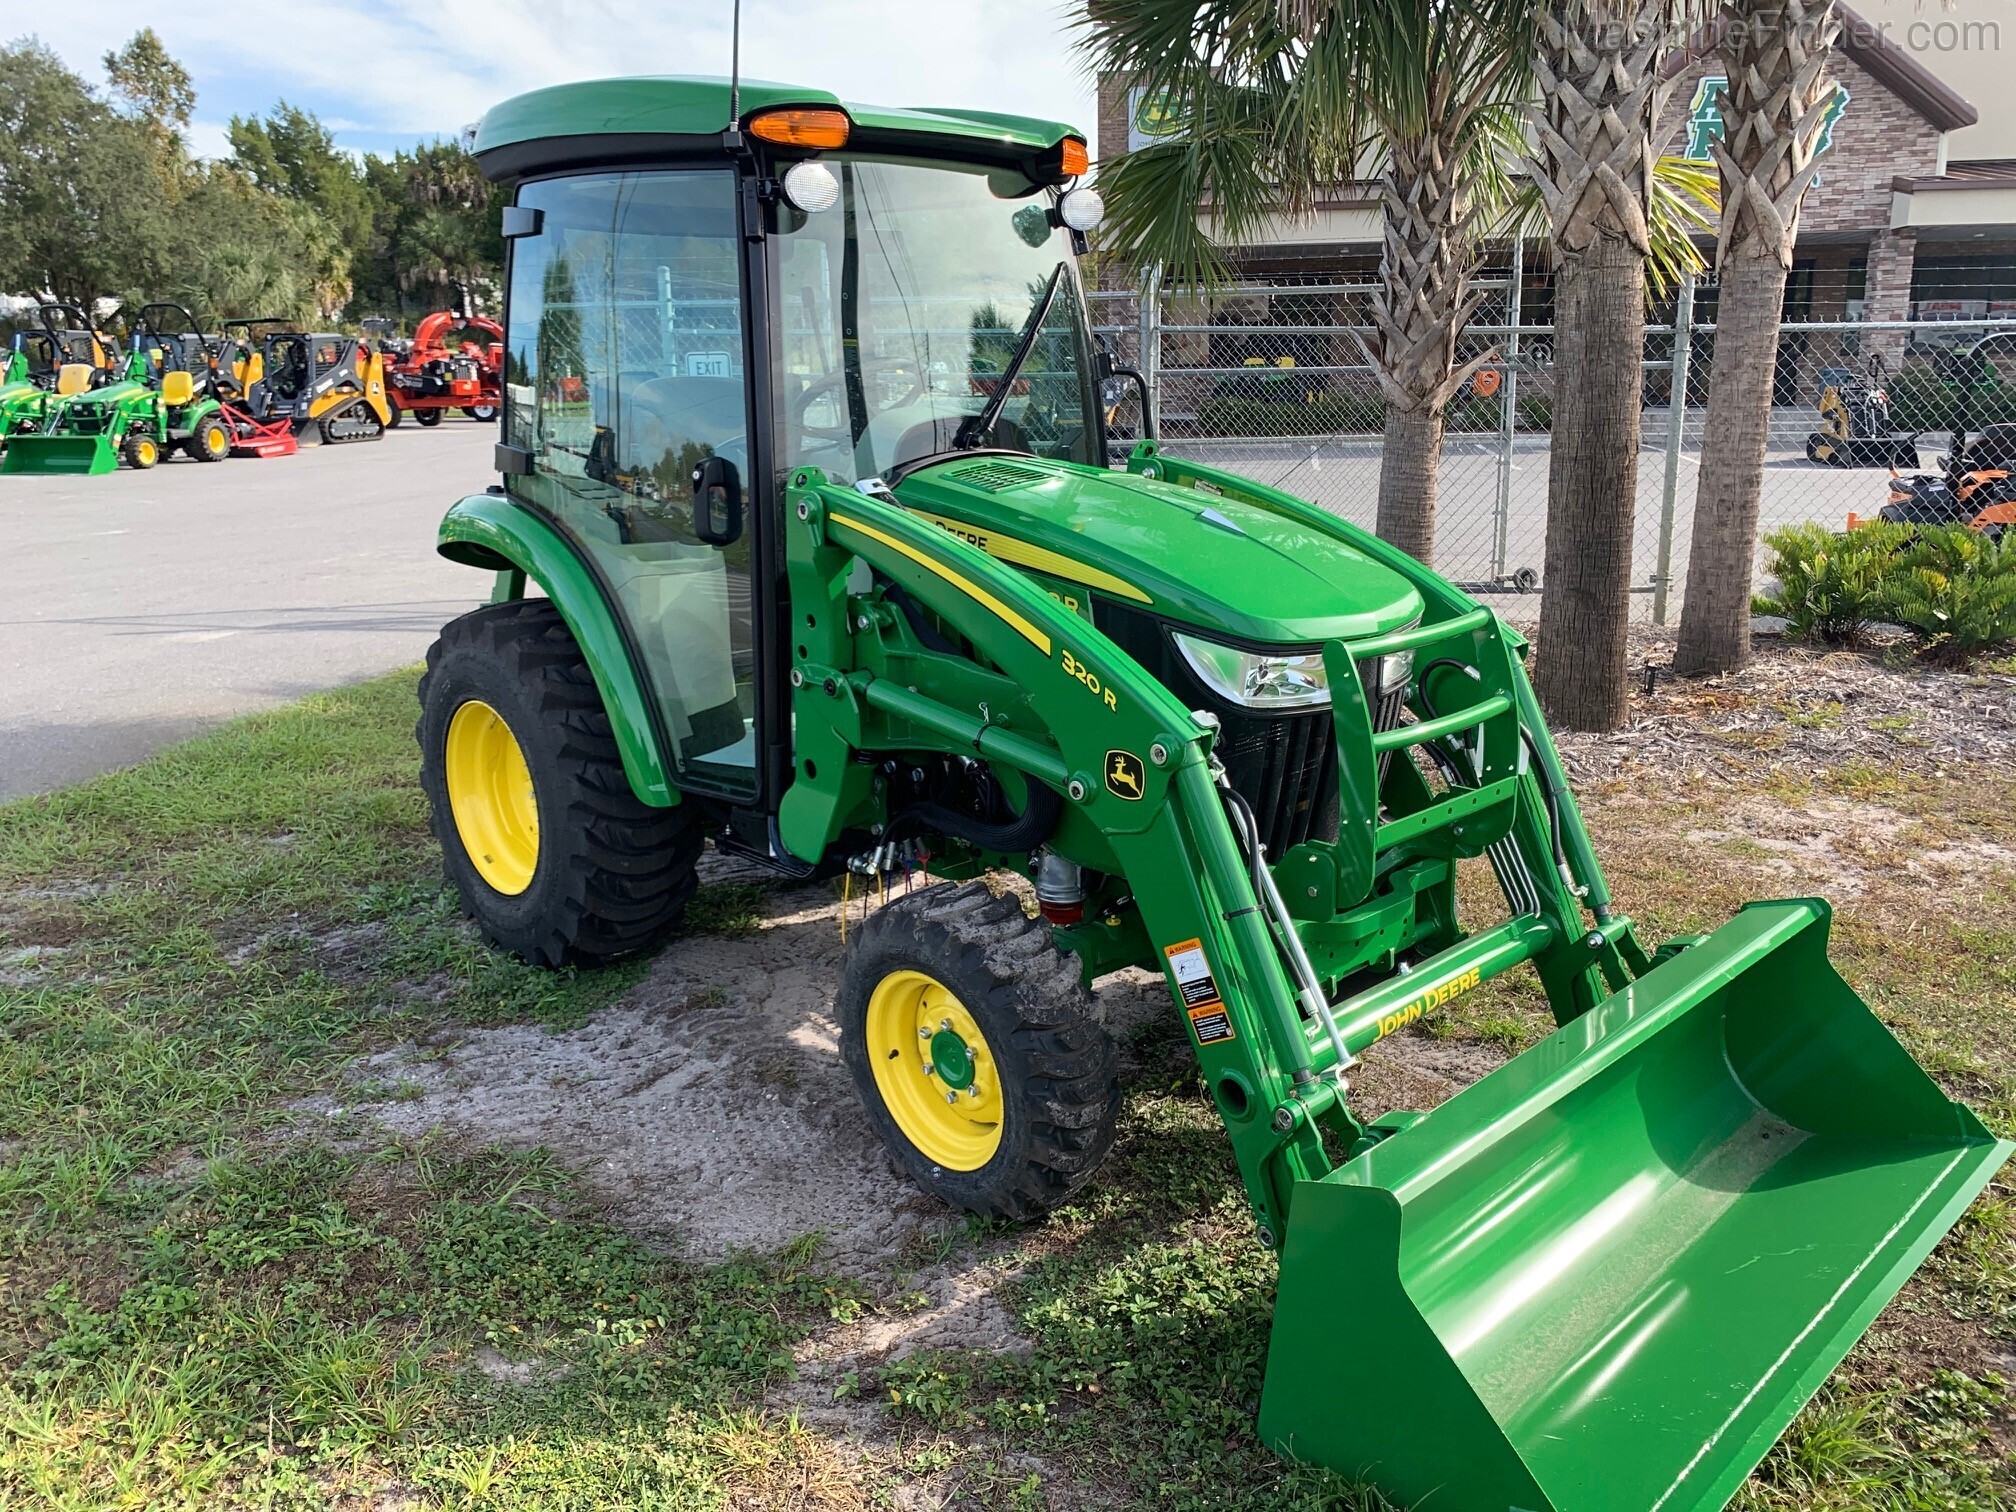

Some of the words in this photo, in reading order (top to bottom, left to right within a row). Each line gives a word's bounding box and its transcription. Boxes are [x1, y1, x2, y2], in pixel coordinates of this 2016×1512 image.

[696, 361, 722, 376] EXIT
[935, 520, 988, 552] DRE
[1061, 648, 1101, 695] 320
[1104, 685, 1118, 714] R
[1174, 941, 1197, 953] WARNING
[1199, 1005, 1222, 1017] WARNING
[1372, 1000, 1423, 1044] JOHN
[1422, 966, 1482, 1013] DEERE
